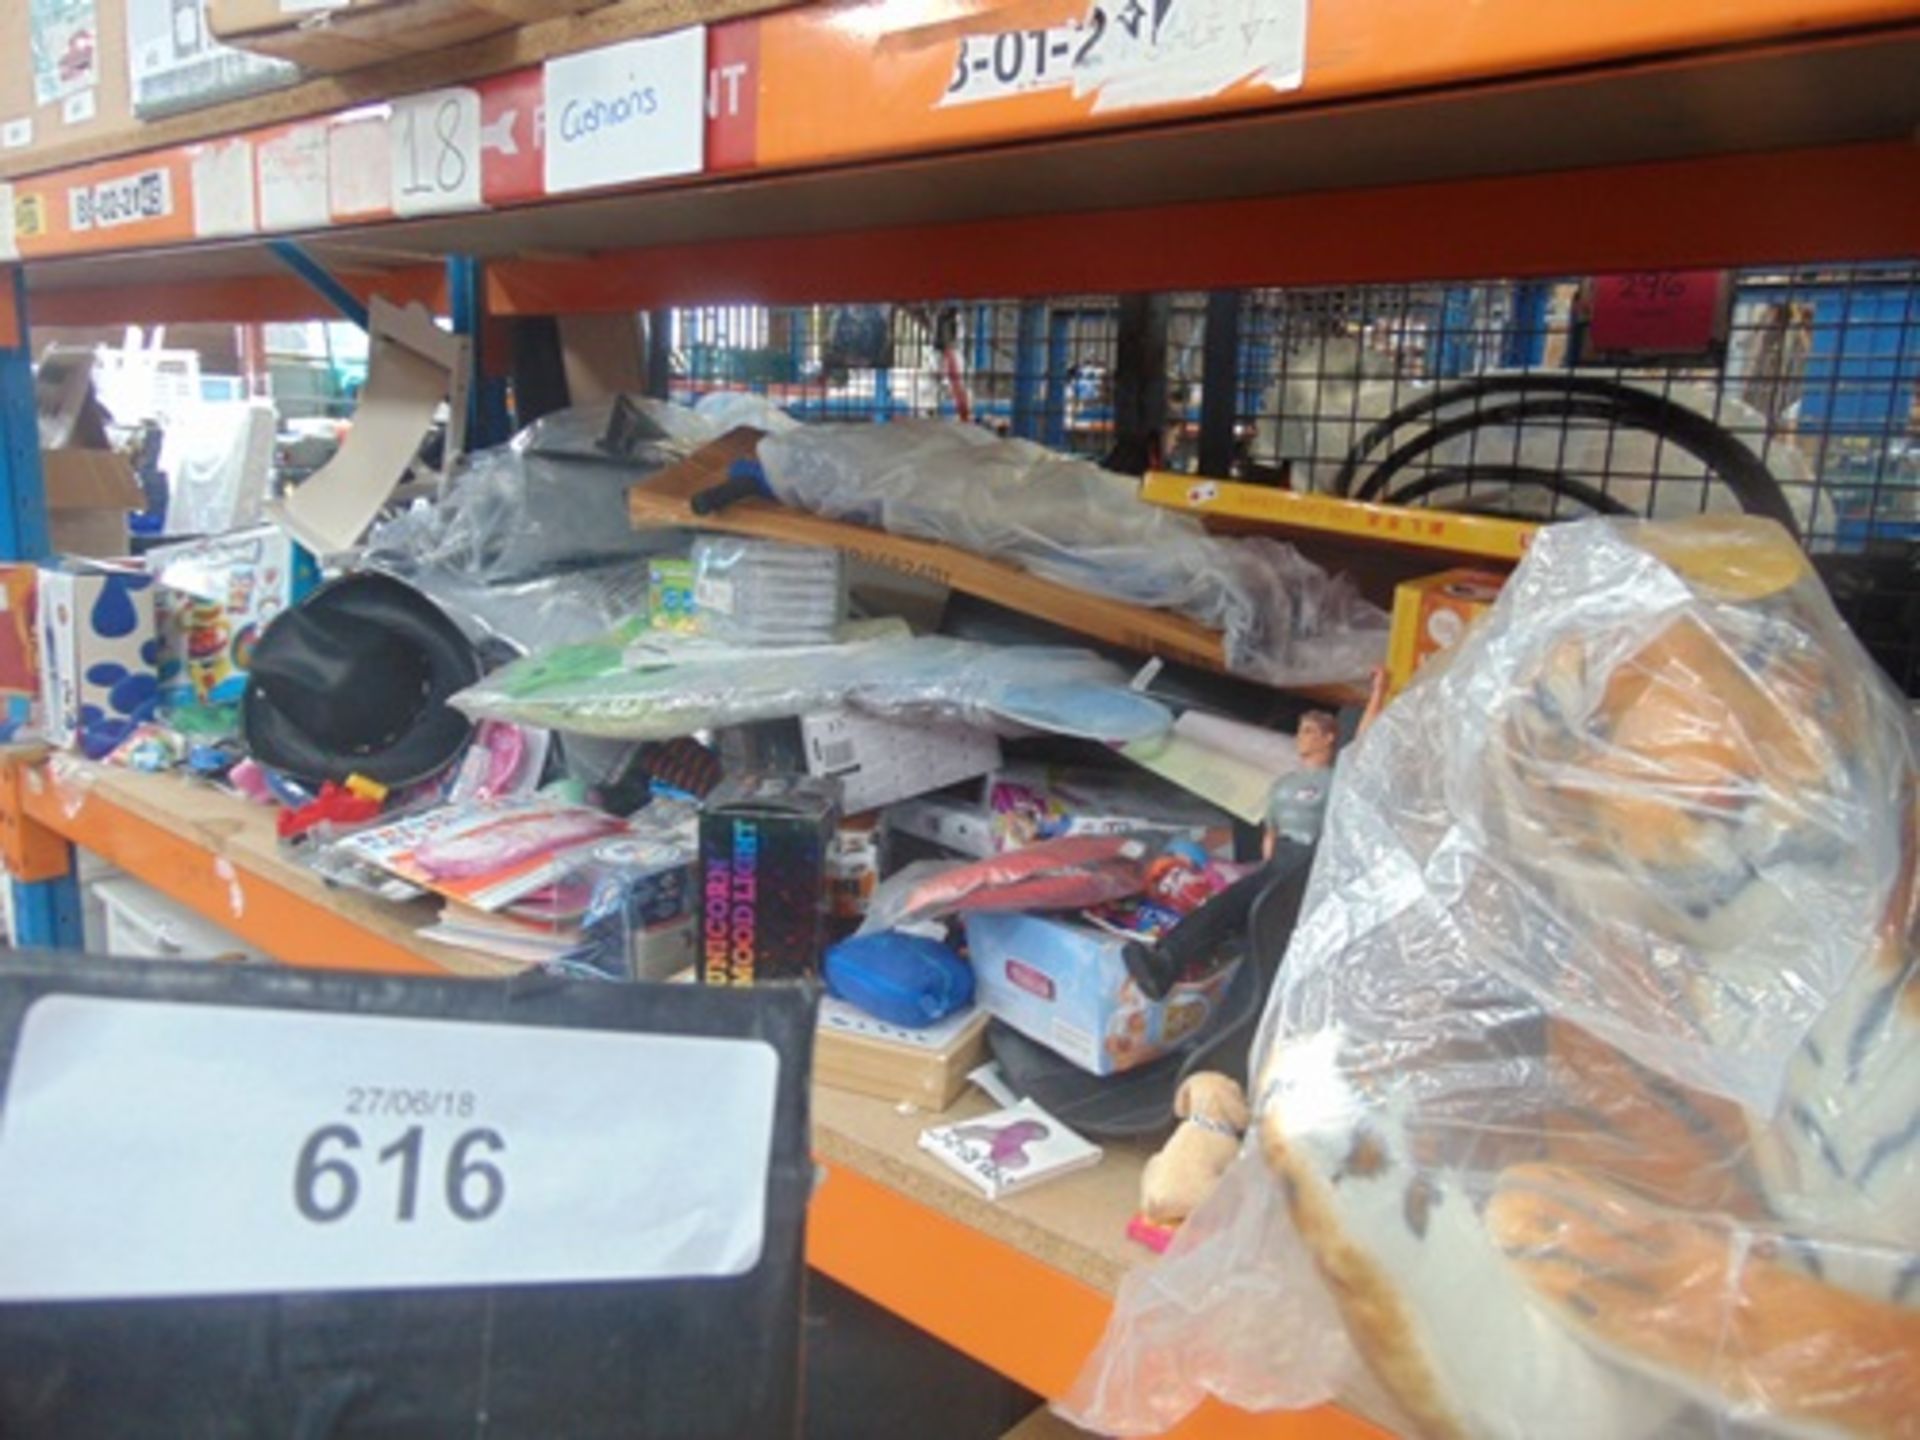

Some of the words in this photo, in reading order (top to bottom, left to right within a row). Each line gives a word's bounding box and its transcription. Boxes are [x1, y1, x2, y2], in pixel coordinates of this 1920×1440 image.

[401, 98, 467, 194] 18
[560, 76, 658, 142] Cushions
[732, 819, 758, 902] LIGHT
[705, 857, 730, 986] UNICORN
[731, 904, 755, 986] MOOD
[346, 1086, 476, 1118] 27/06/18
[294, 1122, 506, 1225] 616
